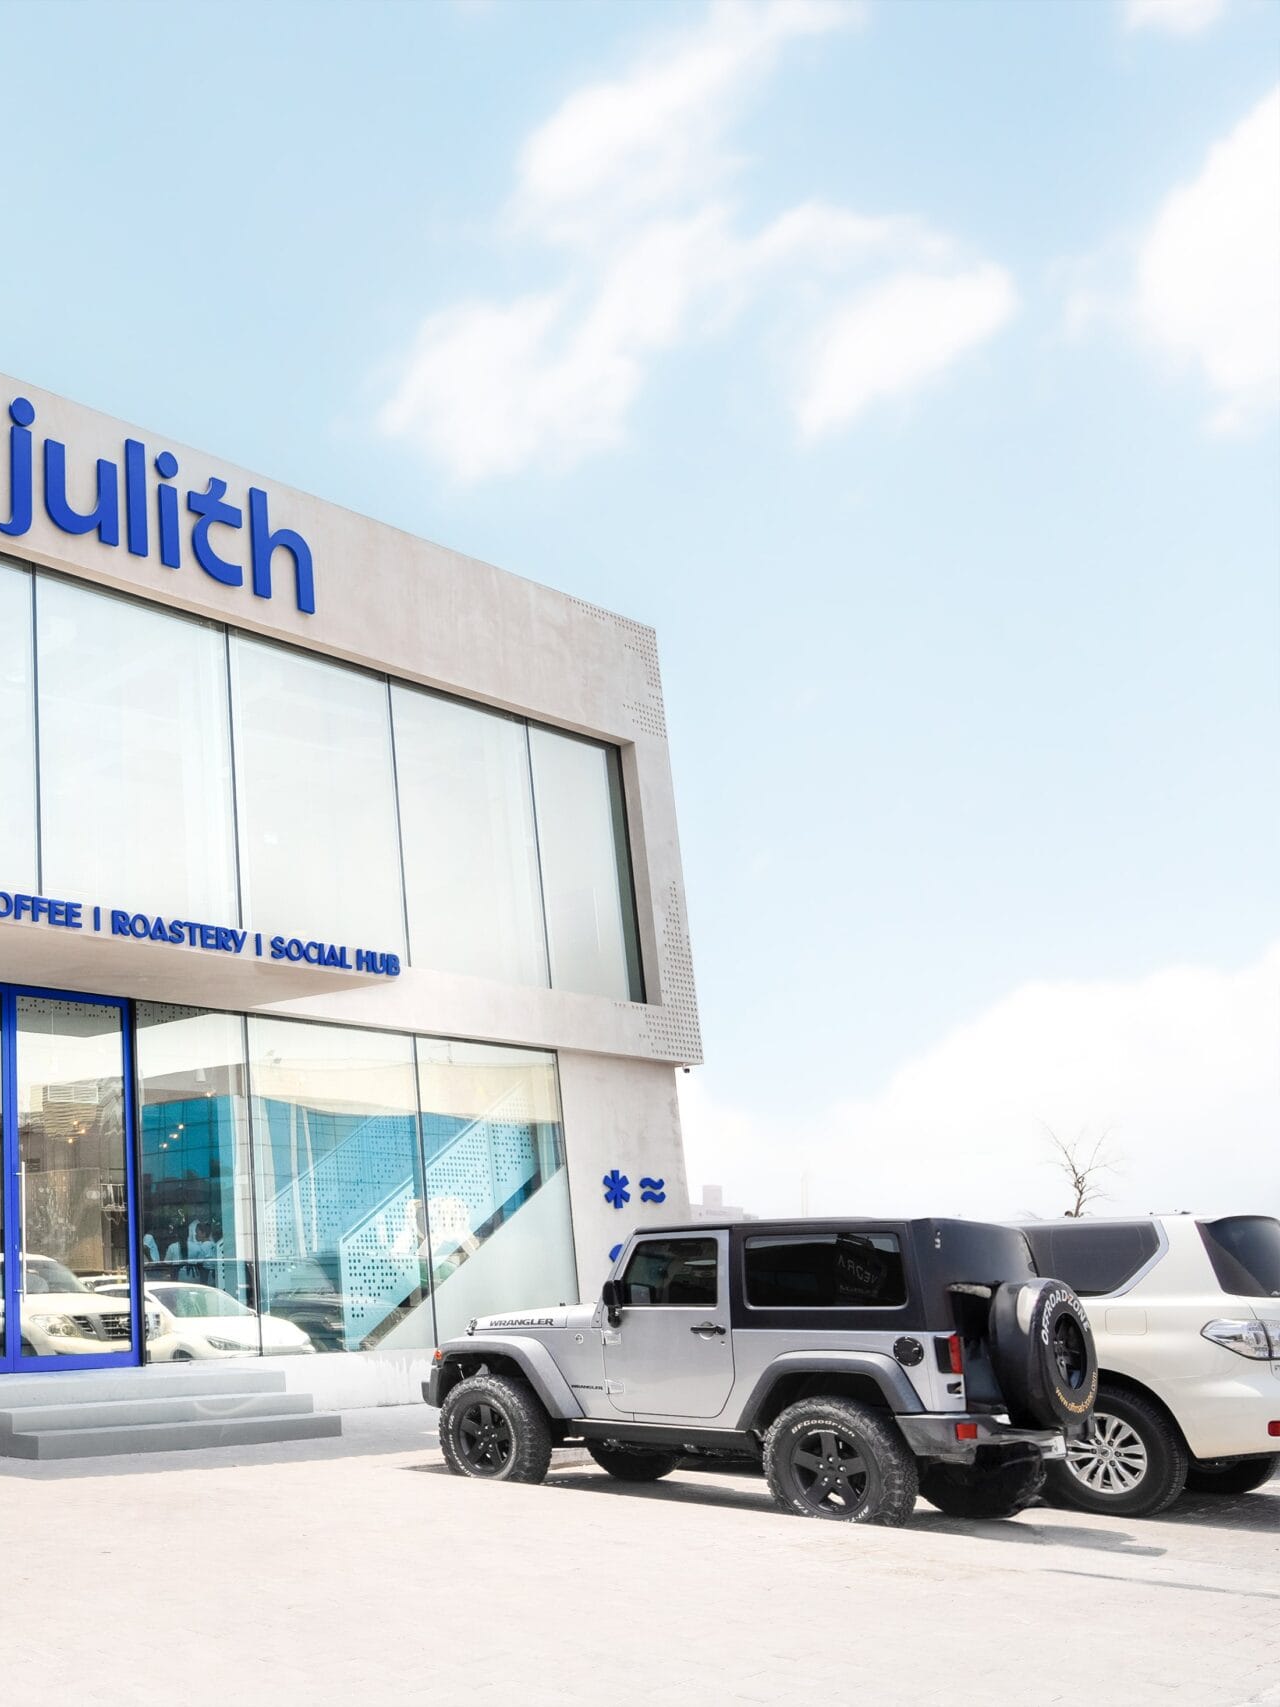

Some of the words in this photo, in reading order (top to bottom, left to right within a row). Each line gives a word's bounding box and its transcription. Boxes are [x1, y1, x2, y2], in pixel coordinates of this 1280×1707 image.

[111, 909, 247, 953] ROASTERY
[270, 936, 353, 970] SOCIAL
[356, 948, 401, 976] HUB
[489, 1318, 554, 1327] WRANGLER
